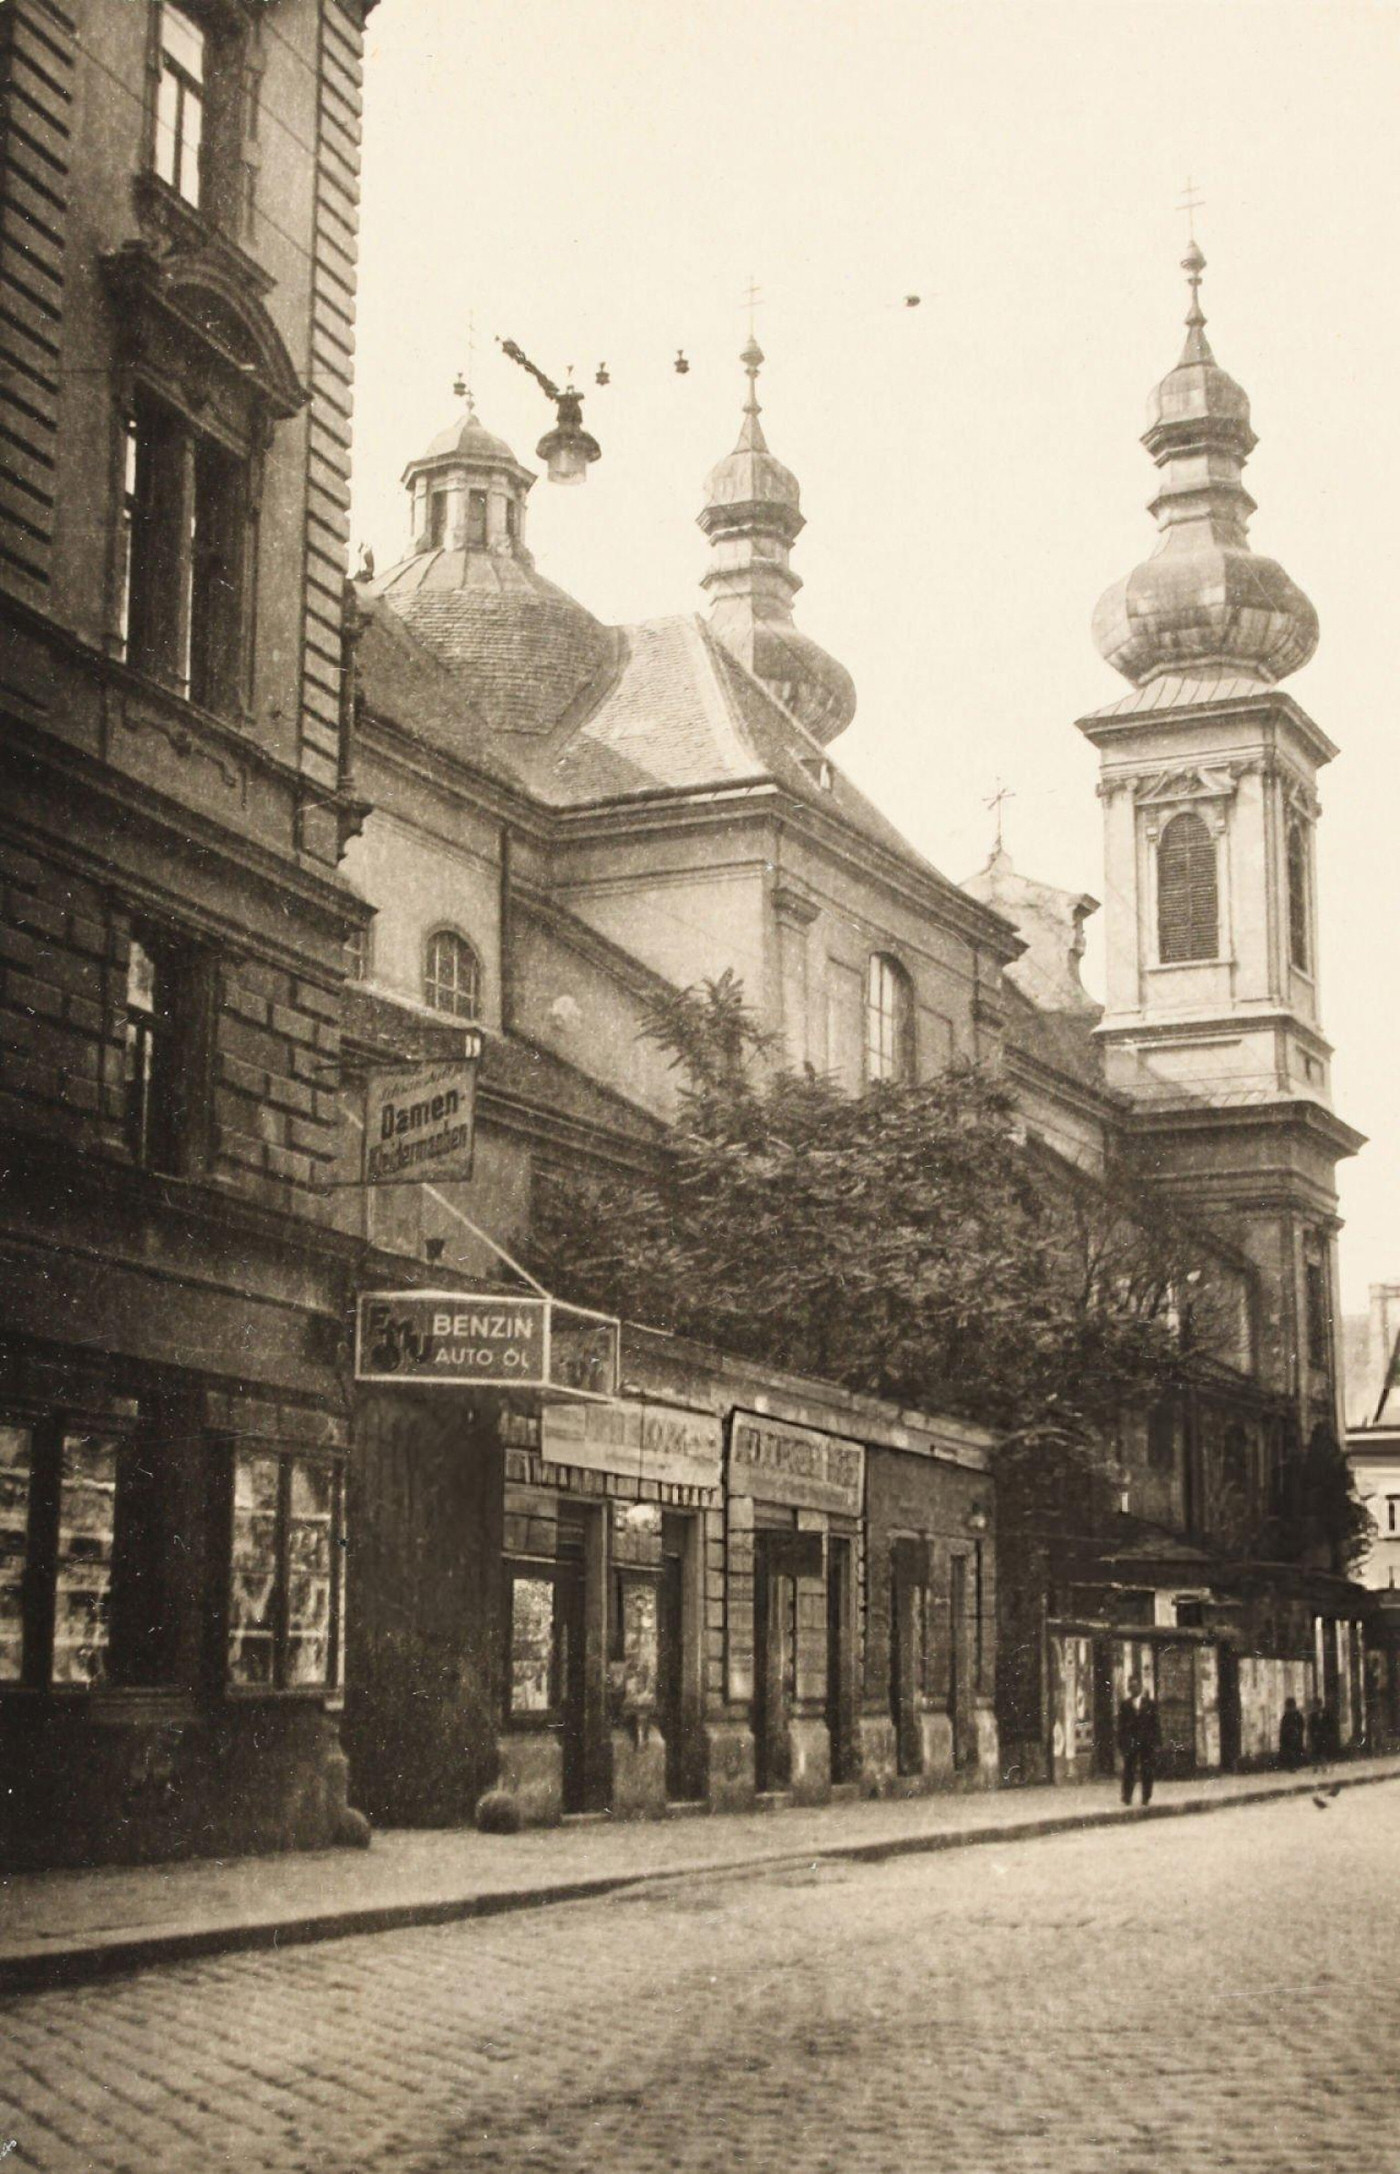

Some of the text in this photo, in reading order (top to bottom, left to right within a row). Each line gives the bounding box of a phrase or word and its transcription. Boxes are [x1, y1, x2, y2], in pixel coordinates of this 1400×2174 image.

[381, 1088, 466, 1140] Damen-
[433, 1314, 533, 1339] BENZIN
[434, 1346, 494, 1366] AUTO
